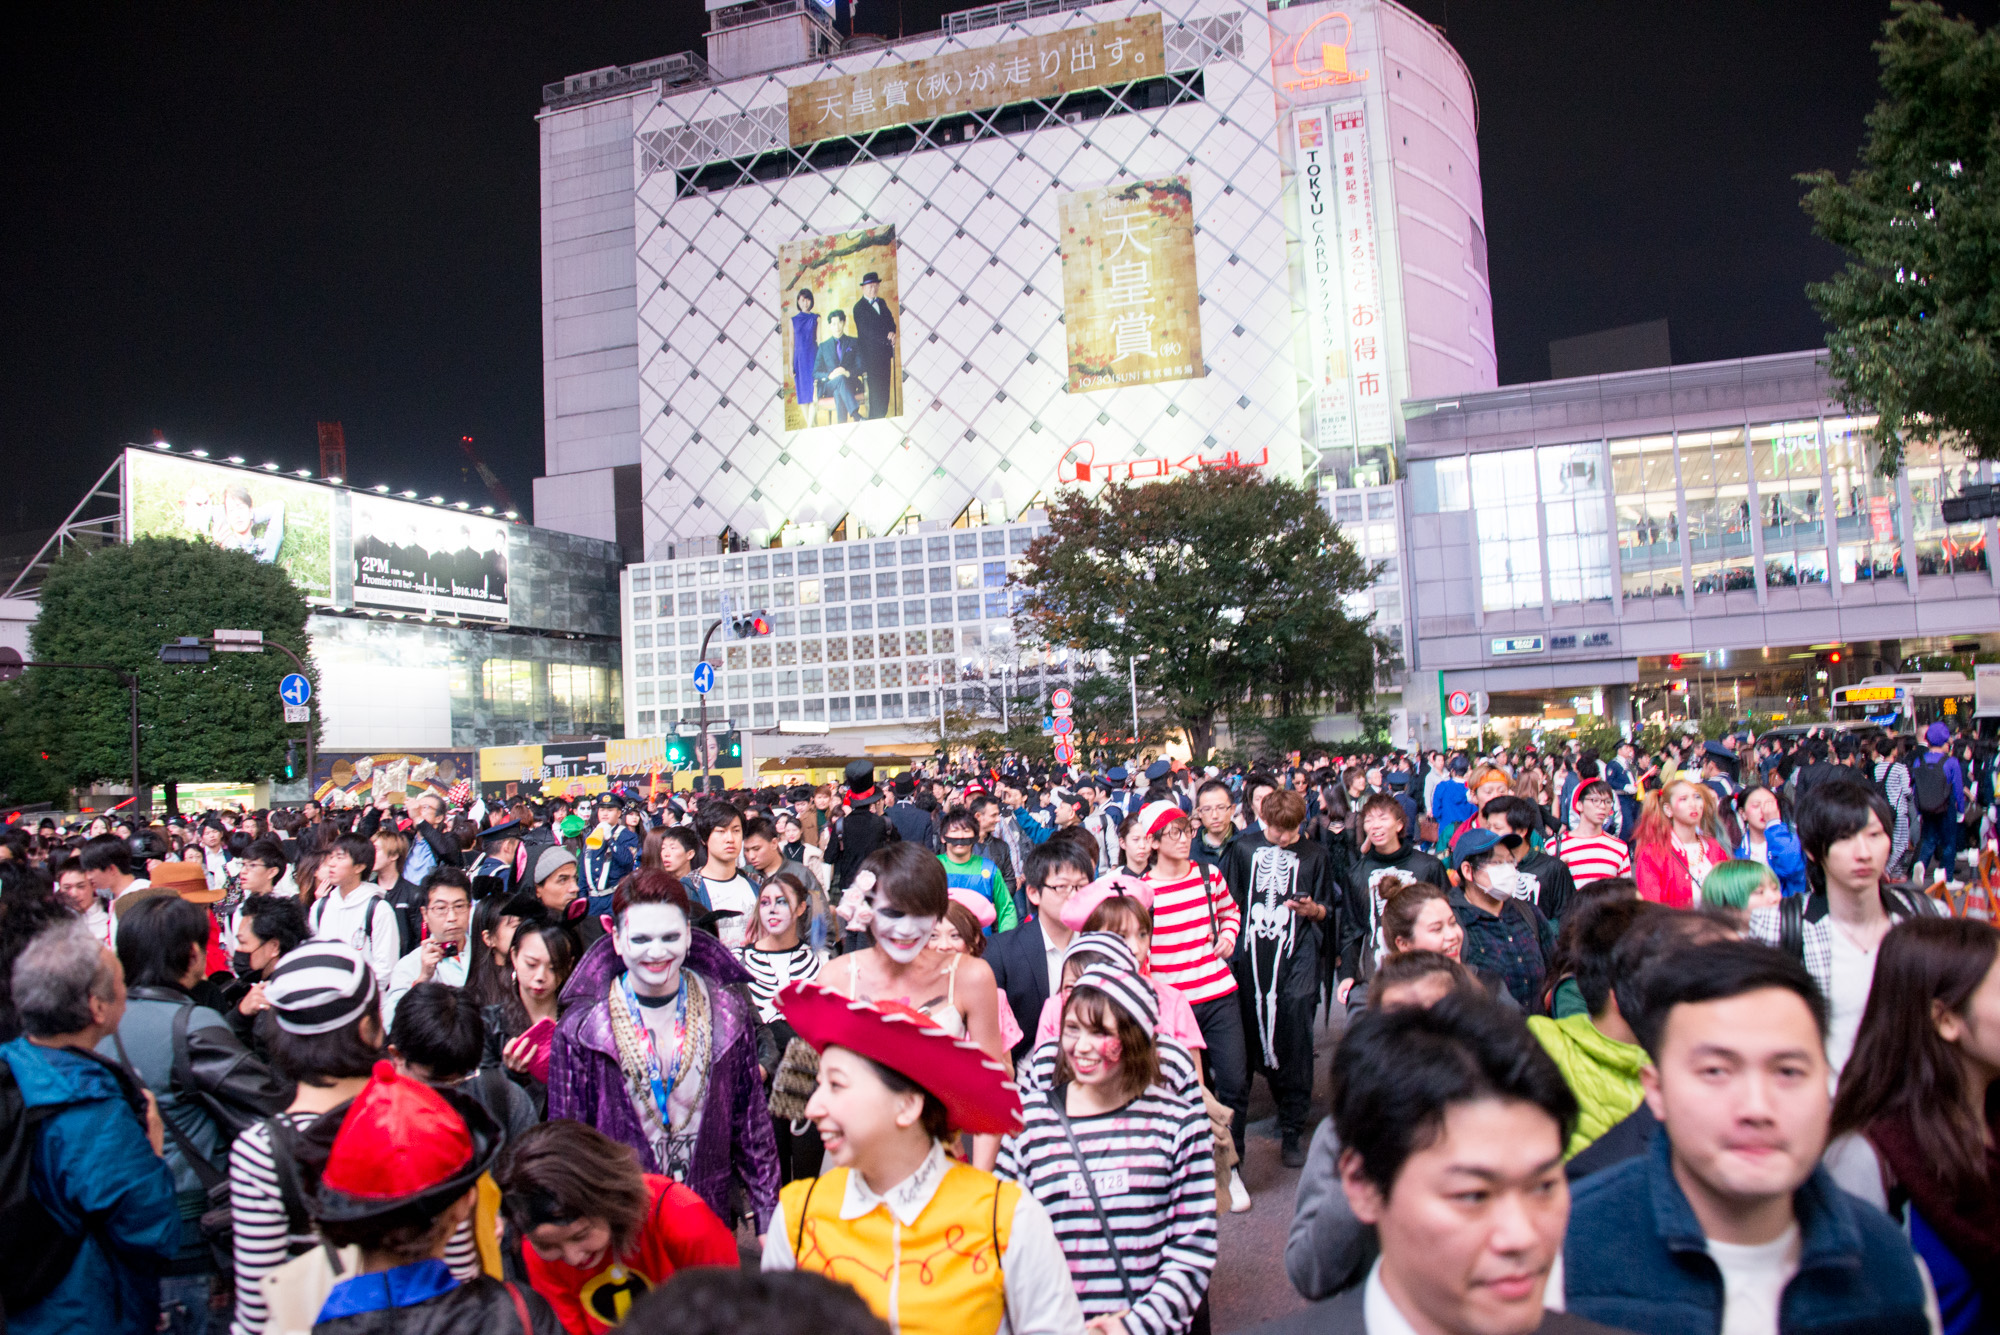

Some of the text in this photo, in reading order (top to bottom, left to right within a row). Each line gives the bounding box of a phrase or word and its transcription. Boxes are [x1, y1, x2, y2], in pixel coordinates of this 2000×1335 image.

[815, 36, 1146, 125] 天皇賞(秋)が走り出す。
[1282, 69, 1369, 92] TOKYU
[1306, 150, 1324, 215] TOKYU
[1312, 219, 1329, 274] CARD
[1101, 209, 1159, 364] 天皇賞
[1093, 446, 1268, 483] TOKYU
[362, 556, 389, 574] 2PM
[362, 573, 392, 587] Promise
